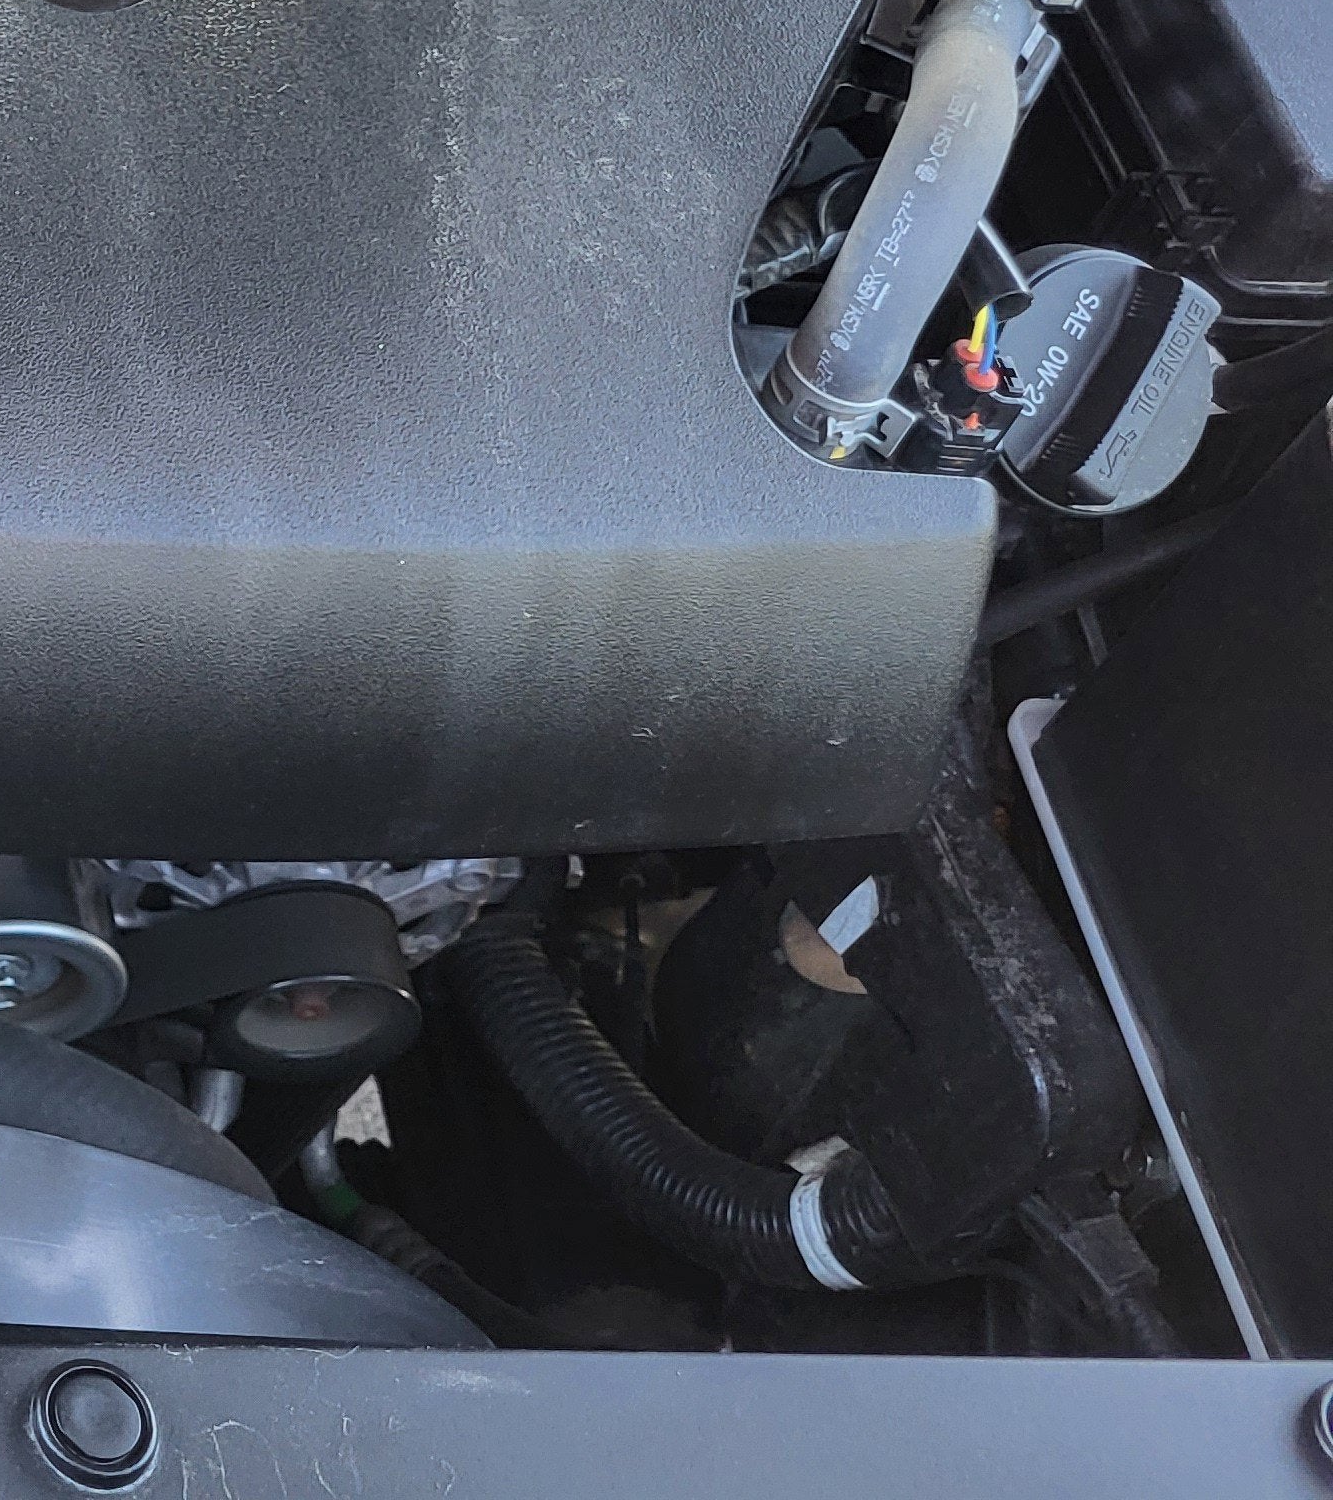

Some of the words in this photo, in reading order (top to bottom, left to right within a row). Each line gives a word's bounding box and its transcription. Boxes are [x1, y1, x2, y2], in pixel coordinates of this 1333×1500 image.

[1061, 287, 1101, 342] SAE
[1147, 297, 1205, 385] ENGINE
[1130, 378, 1161, 418] OIL
